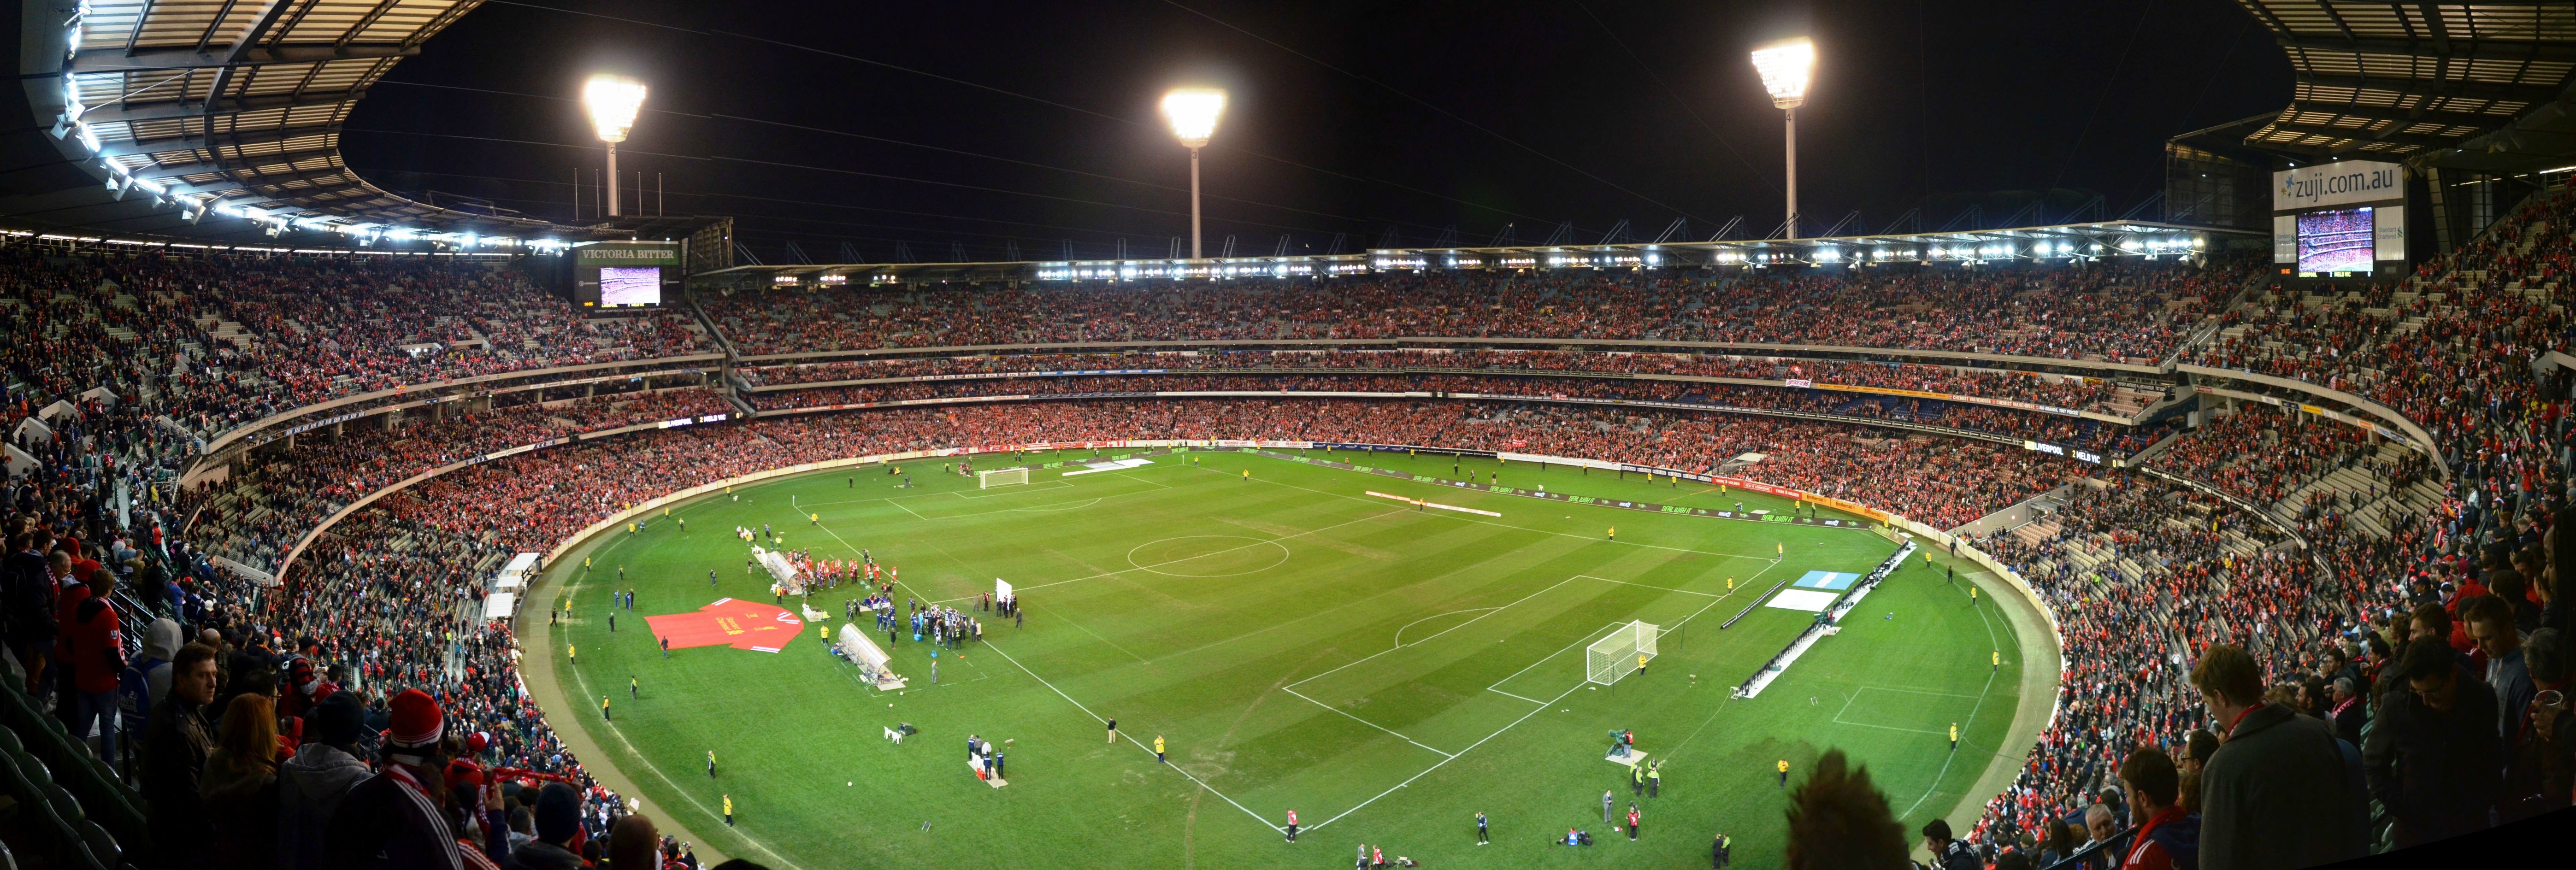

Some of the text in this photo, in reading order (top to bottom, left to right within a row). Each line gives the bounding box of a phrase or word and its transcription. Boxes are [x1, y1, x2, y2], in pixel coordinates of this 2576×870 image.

[2296, 170, 2393, 203] zuji.com.au
[582, 249, 674, 259] VICTORIA BITTER
[668, 418, 693, 427] LIVERPOOL
[2035, 442, 2116, 468] LIVERPOOL 2 MELB VIC 0
